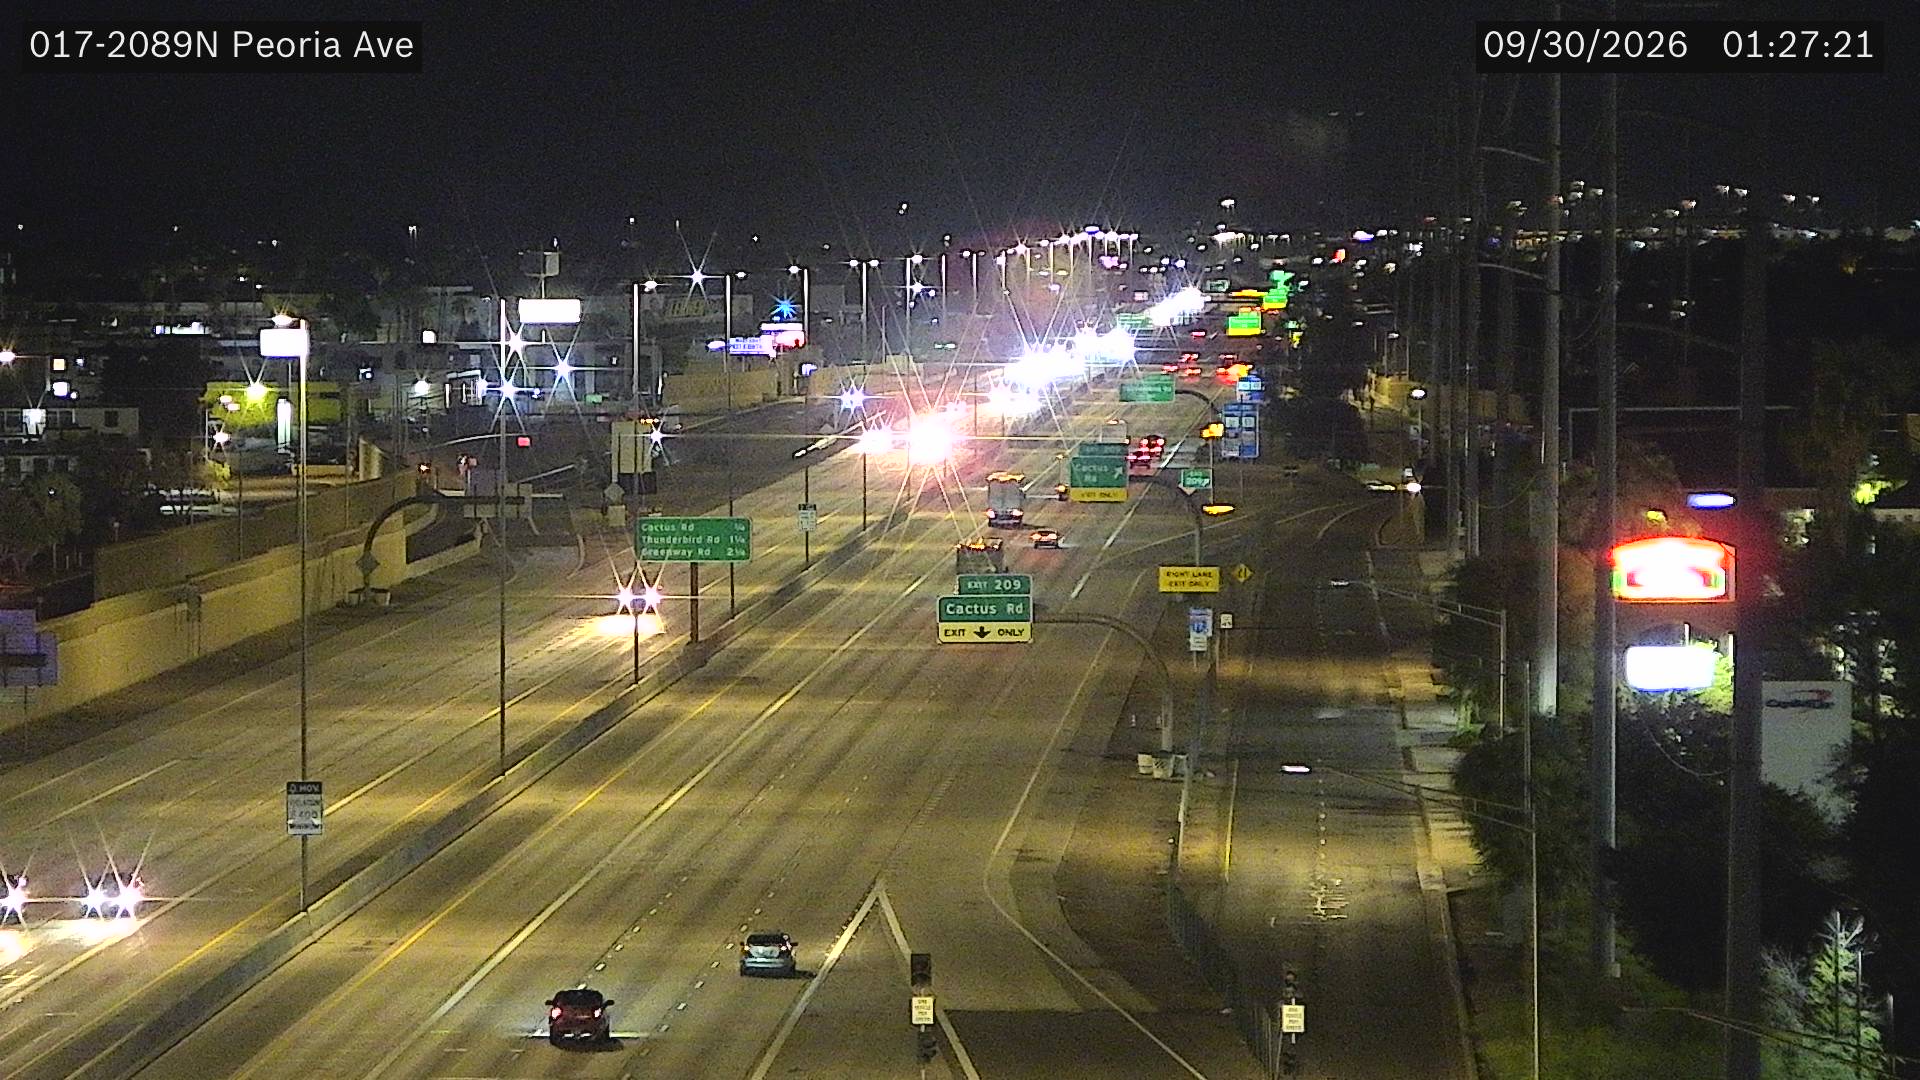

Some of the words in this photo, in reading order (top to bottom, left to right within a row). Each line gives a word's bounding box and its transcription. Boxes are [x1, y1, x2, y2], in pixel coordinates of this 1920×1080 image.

[641, 523, 676, 532] Cactus
[681, 523, 695, 532] Rd
[641, 535, 703, 544] Thunderbird
[706, 535, 721, 544] Rd
[641, 548, 693, 557] Greenway
[697, 547, 711, 556] Rd
[967, 581, 987, 590] EXIT
[994, 579, 1021, 590] 209
[946, 603, 997, 615] Cactus
[1006, 602, 1024, 615] Rd
[944, 628, 966, 637] EXIT
[997, 628, 1025, 637] ONLY
[299, 784, 320, 792] HOV
